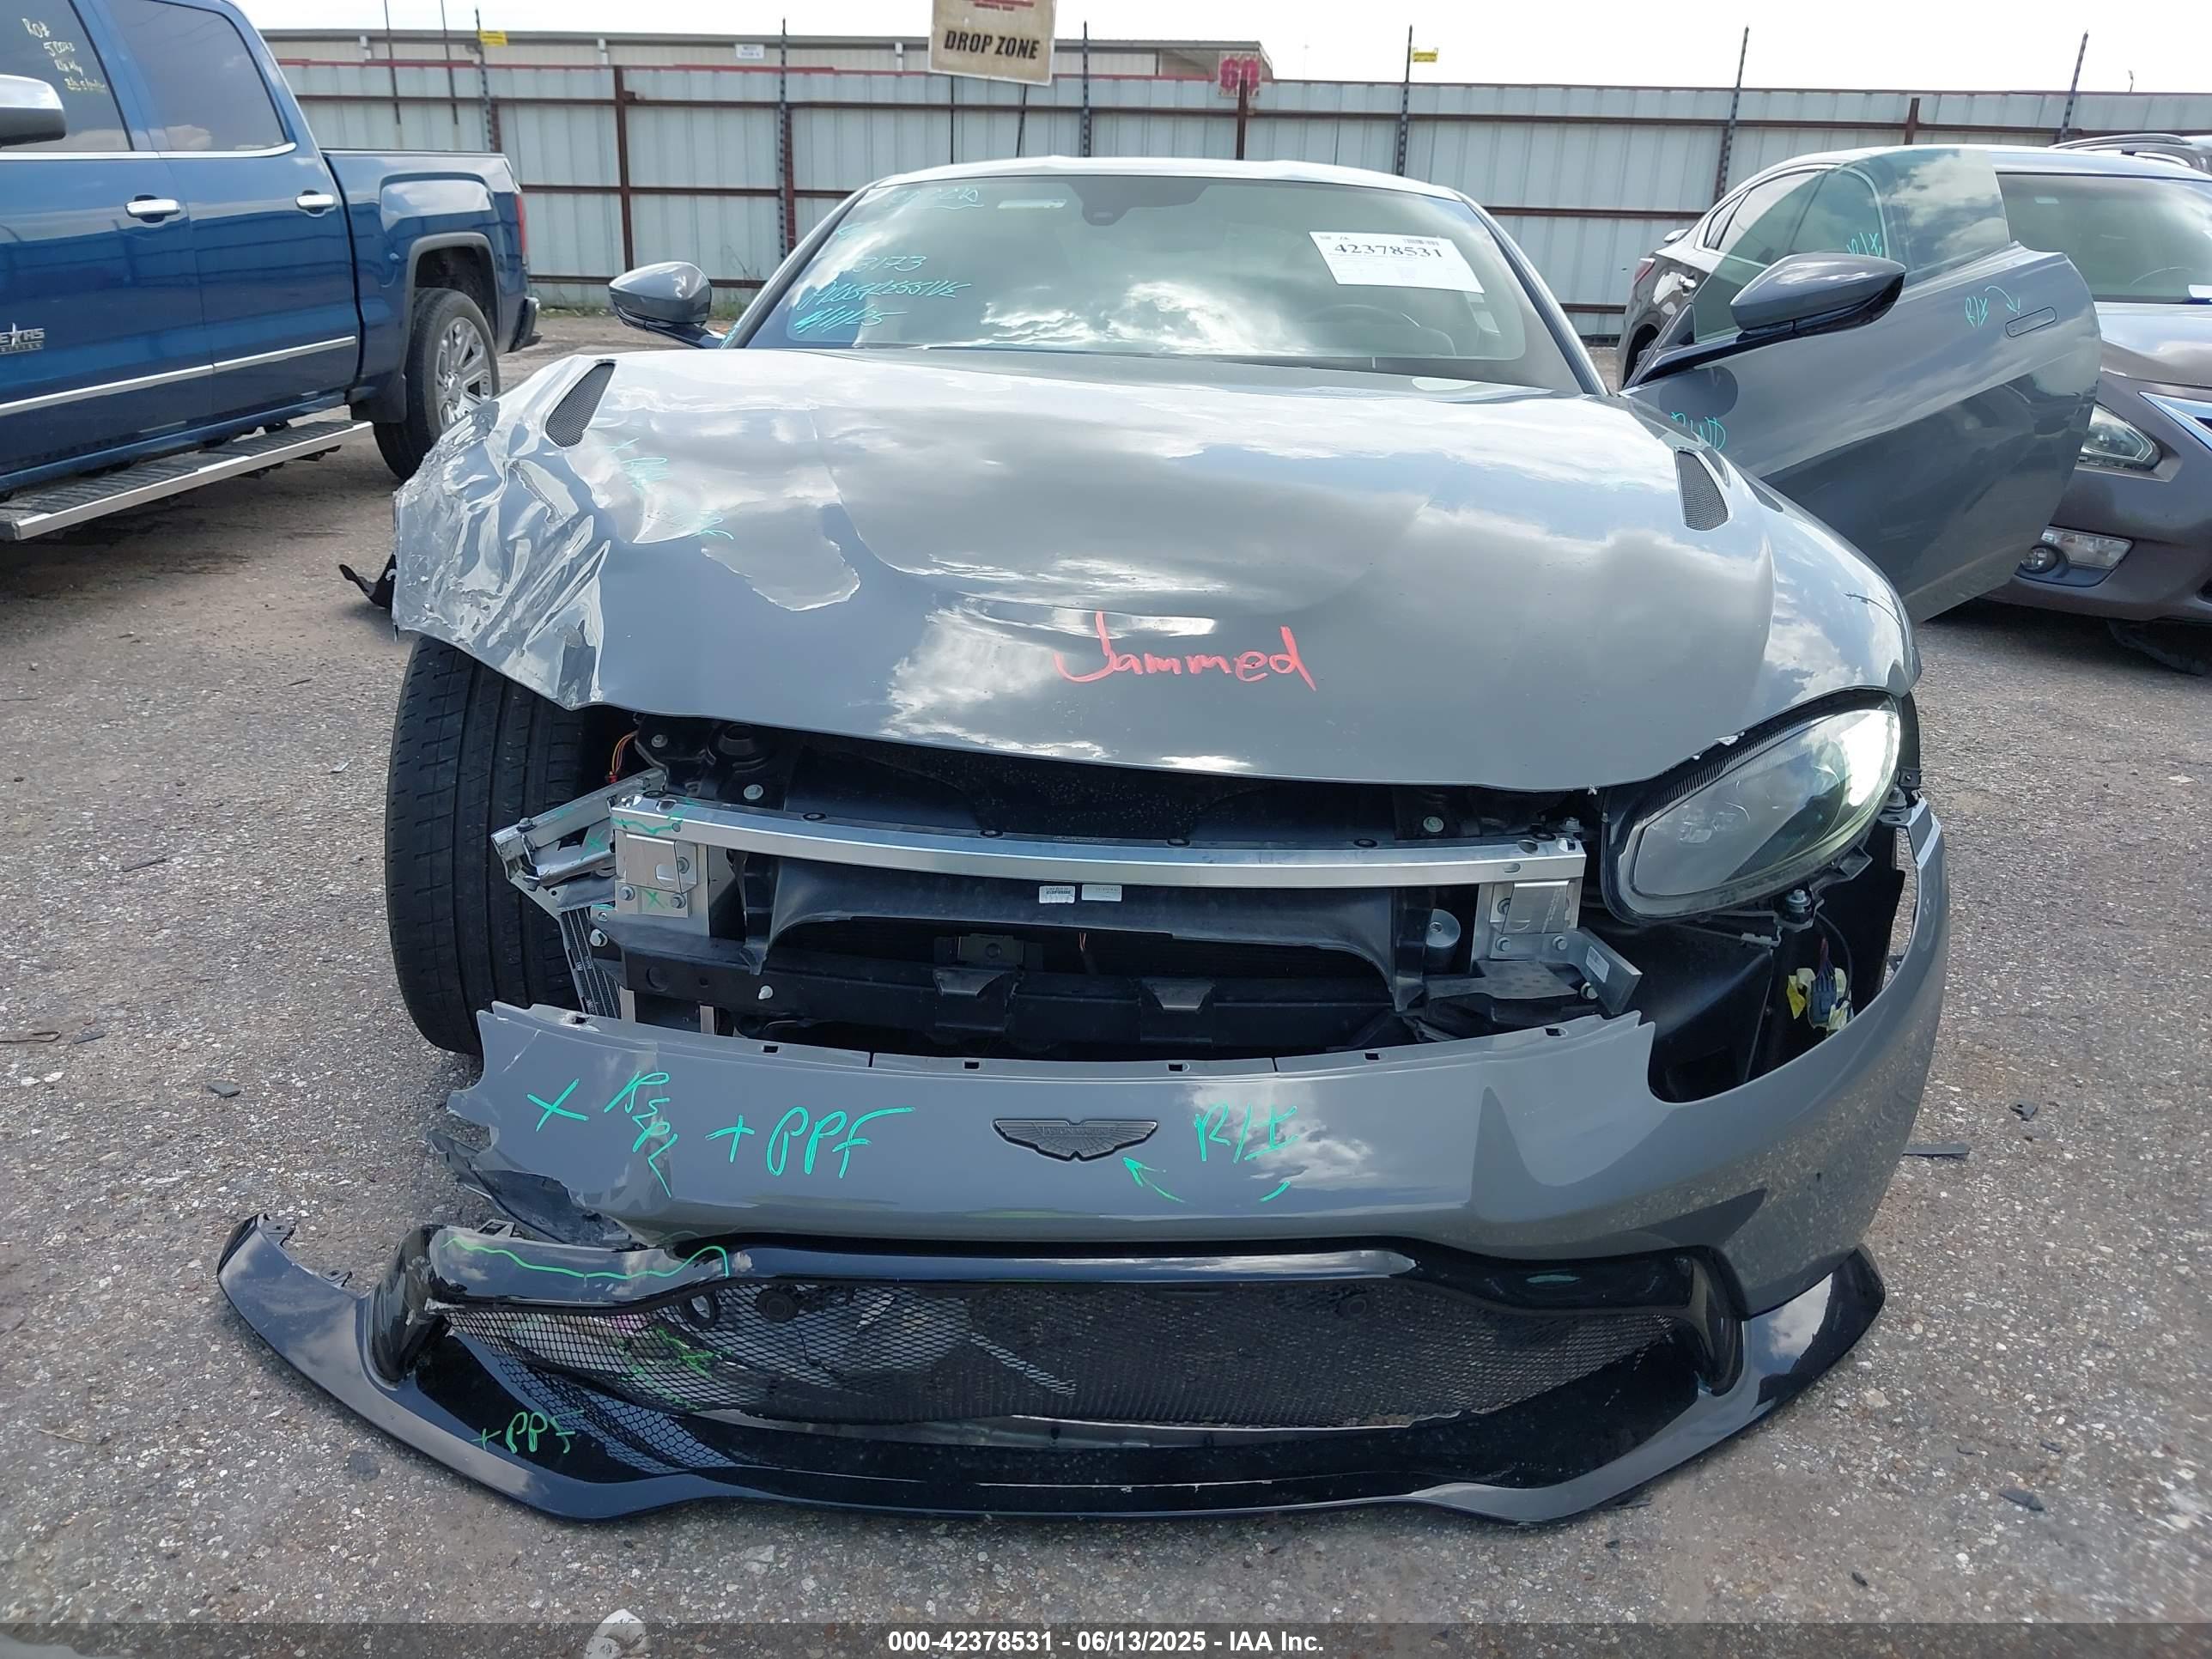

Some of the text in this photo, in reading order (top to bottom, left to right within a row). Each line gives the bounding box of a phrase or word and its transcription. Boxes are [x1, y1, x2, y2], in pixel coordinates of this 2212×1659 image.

[944, 29, 1040, 60] DROP ZONE
[1334, 244, 1443, 258] 42378531
[1054, 610, 1316, 691] Jammed
